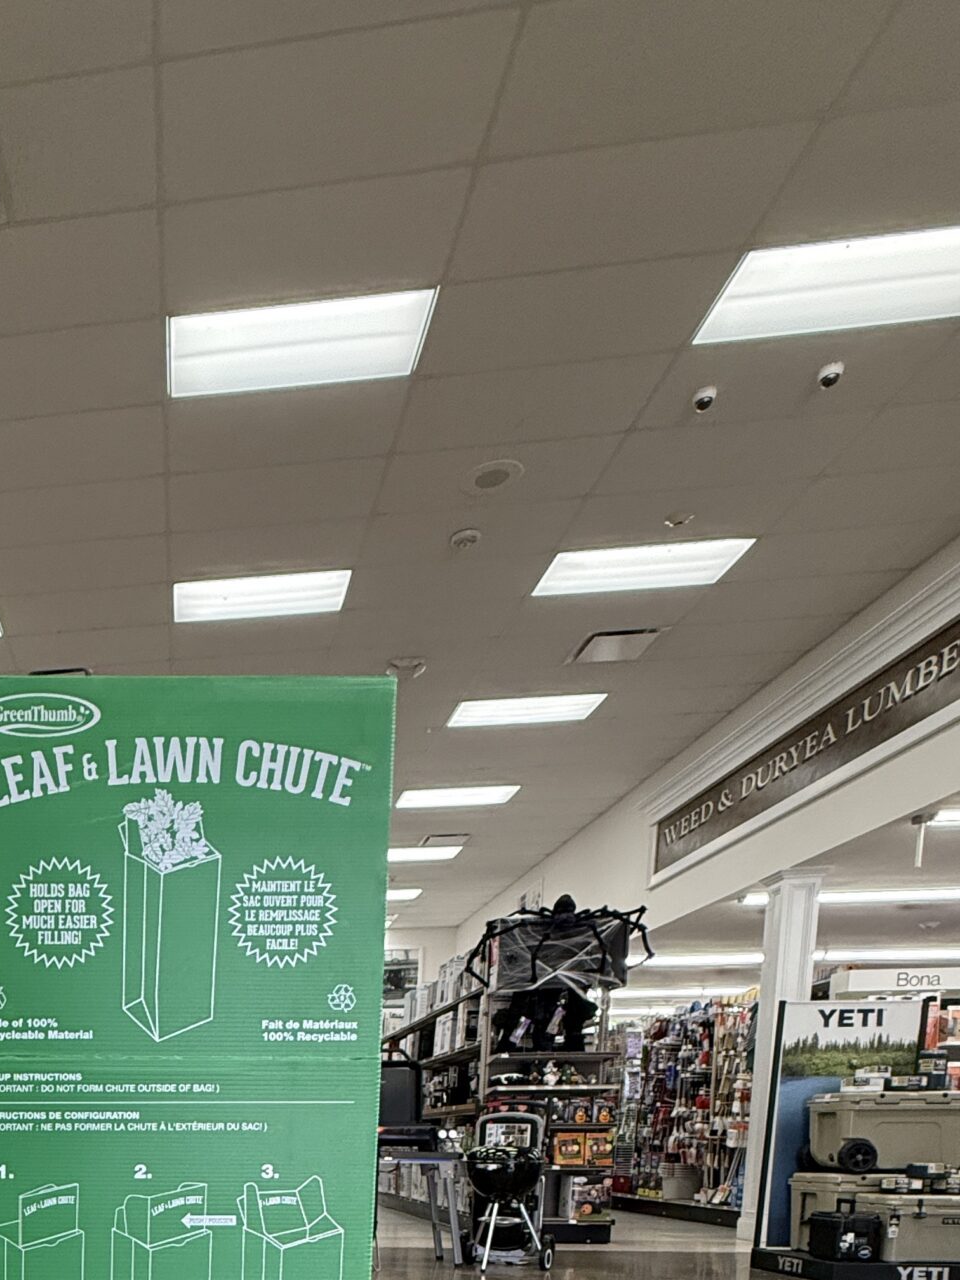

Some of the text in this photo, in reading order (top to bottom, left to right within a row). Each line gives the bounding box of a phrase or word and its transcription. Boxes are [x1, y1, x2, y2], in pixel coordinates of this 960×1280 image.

[82, 753, 98, 781] &
[105, 736, 224, 786] LAWN
[664, 801, 714, 846] WEED
[717, 789, 734, 813] &
[740, 724, 837, 801] DURYEA
[29, 883, 90, 897] HOLDS BAG
[251, 880, 315, 892] MAINTIENT LE
[33, 898, 86, 913] OPEN FOR
[241, 894, 325, 907] SAC OUVERT POUR
[22, 914, 97, 929] MUCH EASIER
[244, 909, 320, 921] LE REMPLISSAGE
[246, 923, 318, 936] BEAUCOUP PLUS
[37, 930, 81, 944] FILLING!
[266, 938, 298, 950] FACILE!
[896, 972, 941, 987] Bona
[11, 1018, 23, 1028] of
[26, 1017, 58, 1028] 100%
[261, 1019, 283, 1029] Fait
[284, 1019, 300, 1029] de
[818, 1008, 884, 1028] YETI
[47, 1029, 93, 1039] Material
[262, 1031, 358, 1042] 100% Recyclable
[13, 1072, 82, 1081] INSTRUCTIONS
[40, 1084, 54, 1092] DO
[56, 1084, 75, 1092] NOT
[76, 1083, 103, 1092] FORM
[104, 1083, 136, 1092] CHUTE
[137, 1083, 177, 1092] OUTSIDE
[177, 1083, 191, 1092] OF
[192, 1083, 215, 1092] BAG!
[48, 1111, 62, 1119] DE
[63, 1111, 140, 1120] CONFIGURATION
[40, 1122, 52, 1131] NE
[54, 1122, 72, 1131] PAS
[74, 1122, 112, 1131] FORMER
[114, 1122, 125, 1131] LA
[126, 1122, 158, 1131] CHUTE
[226, 1122, 240, 1131] DU
[240, 1121, 262, 1131] SAC!
[134, 1164, 152, 1179] 2.
[261, 1164, 279, 1179] 3.
[778, 1256, 803, 1274] YETI
